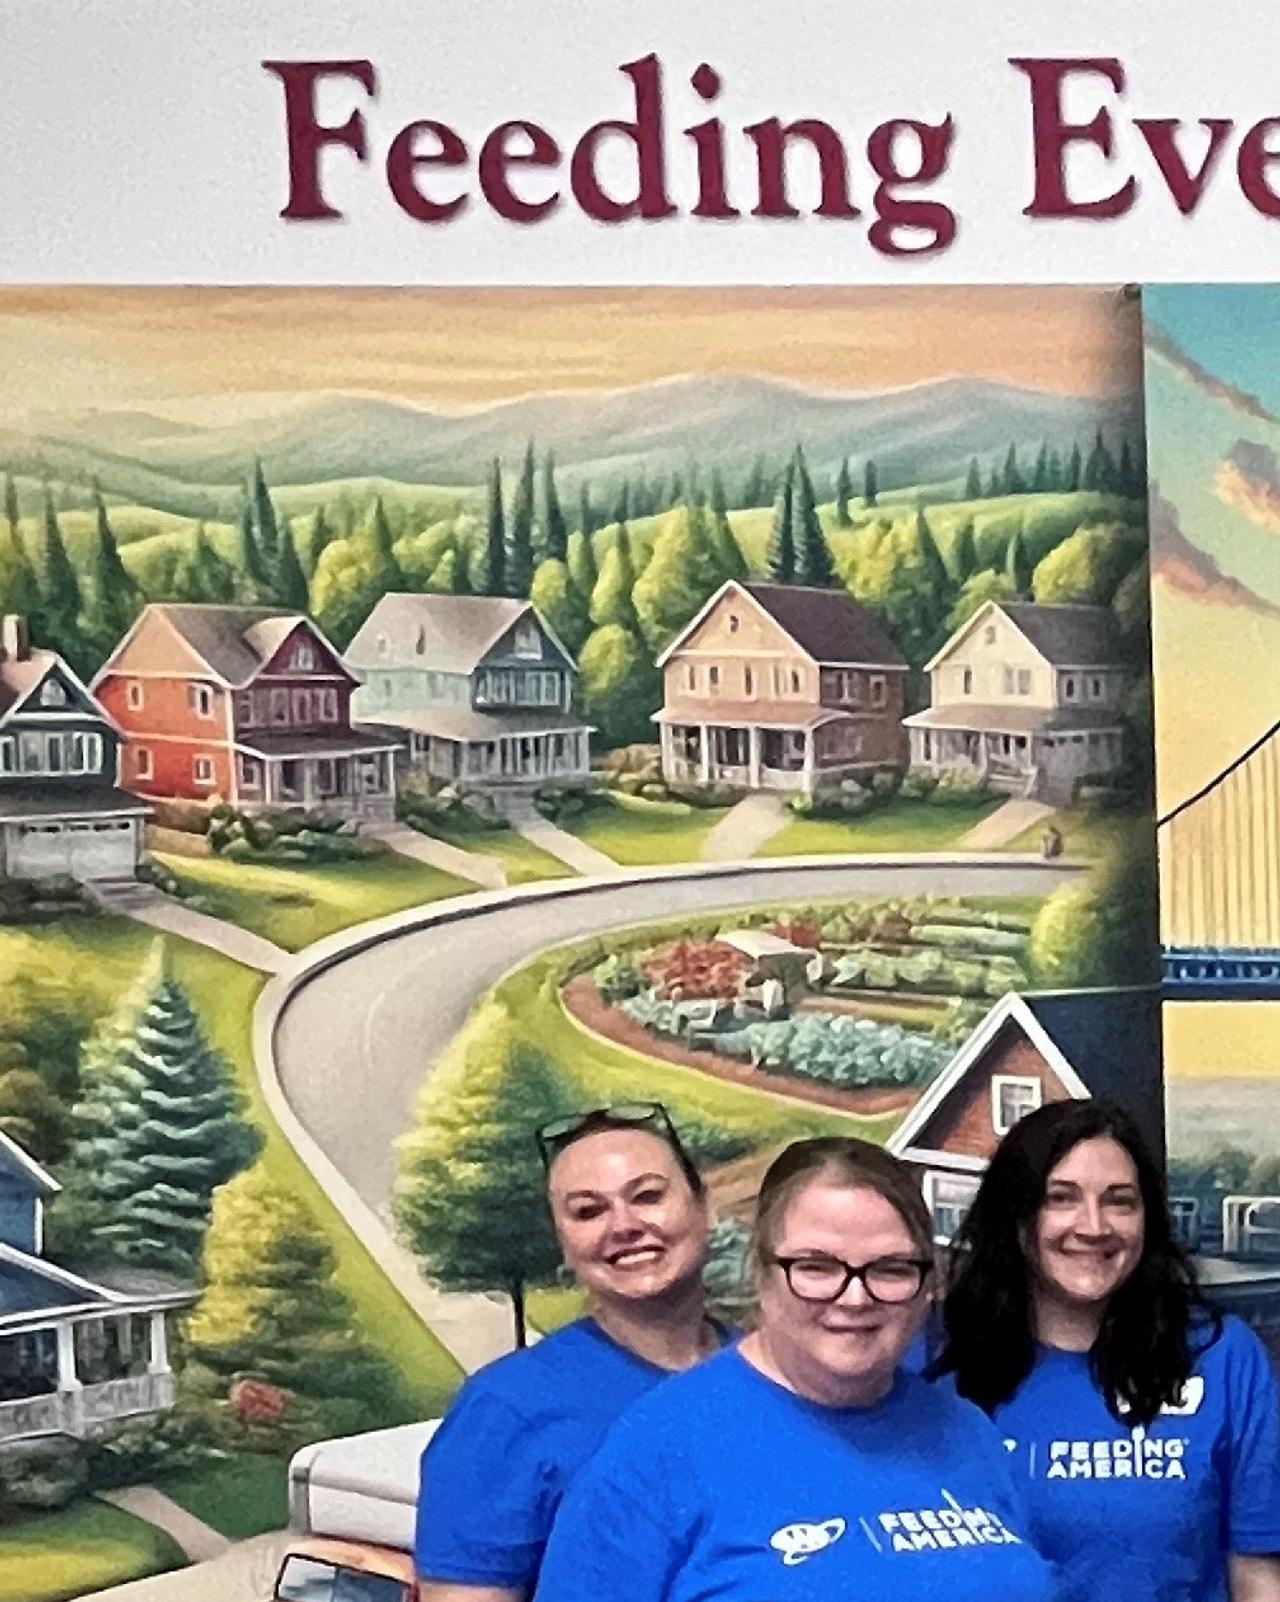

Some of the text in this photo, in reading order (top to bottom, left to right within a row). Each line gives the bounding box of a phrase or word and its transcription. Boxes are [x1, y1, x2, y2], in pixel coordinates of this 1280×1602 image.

[261, 52, 957, 259] Feeding
[1050, 1438, 1185, 1461] FEEDING
[1047, 1459, 1187, 1480] AMERICA
